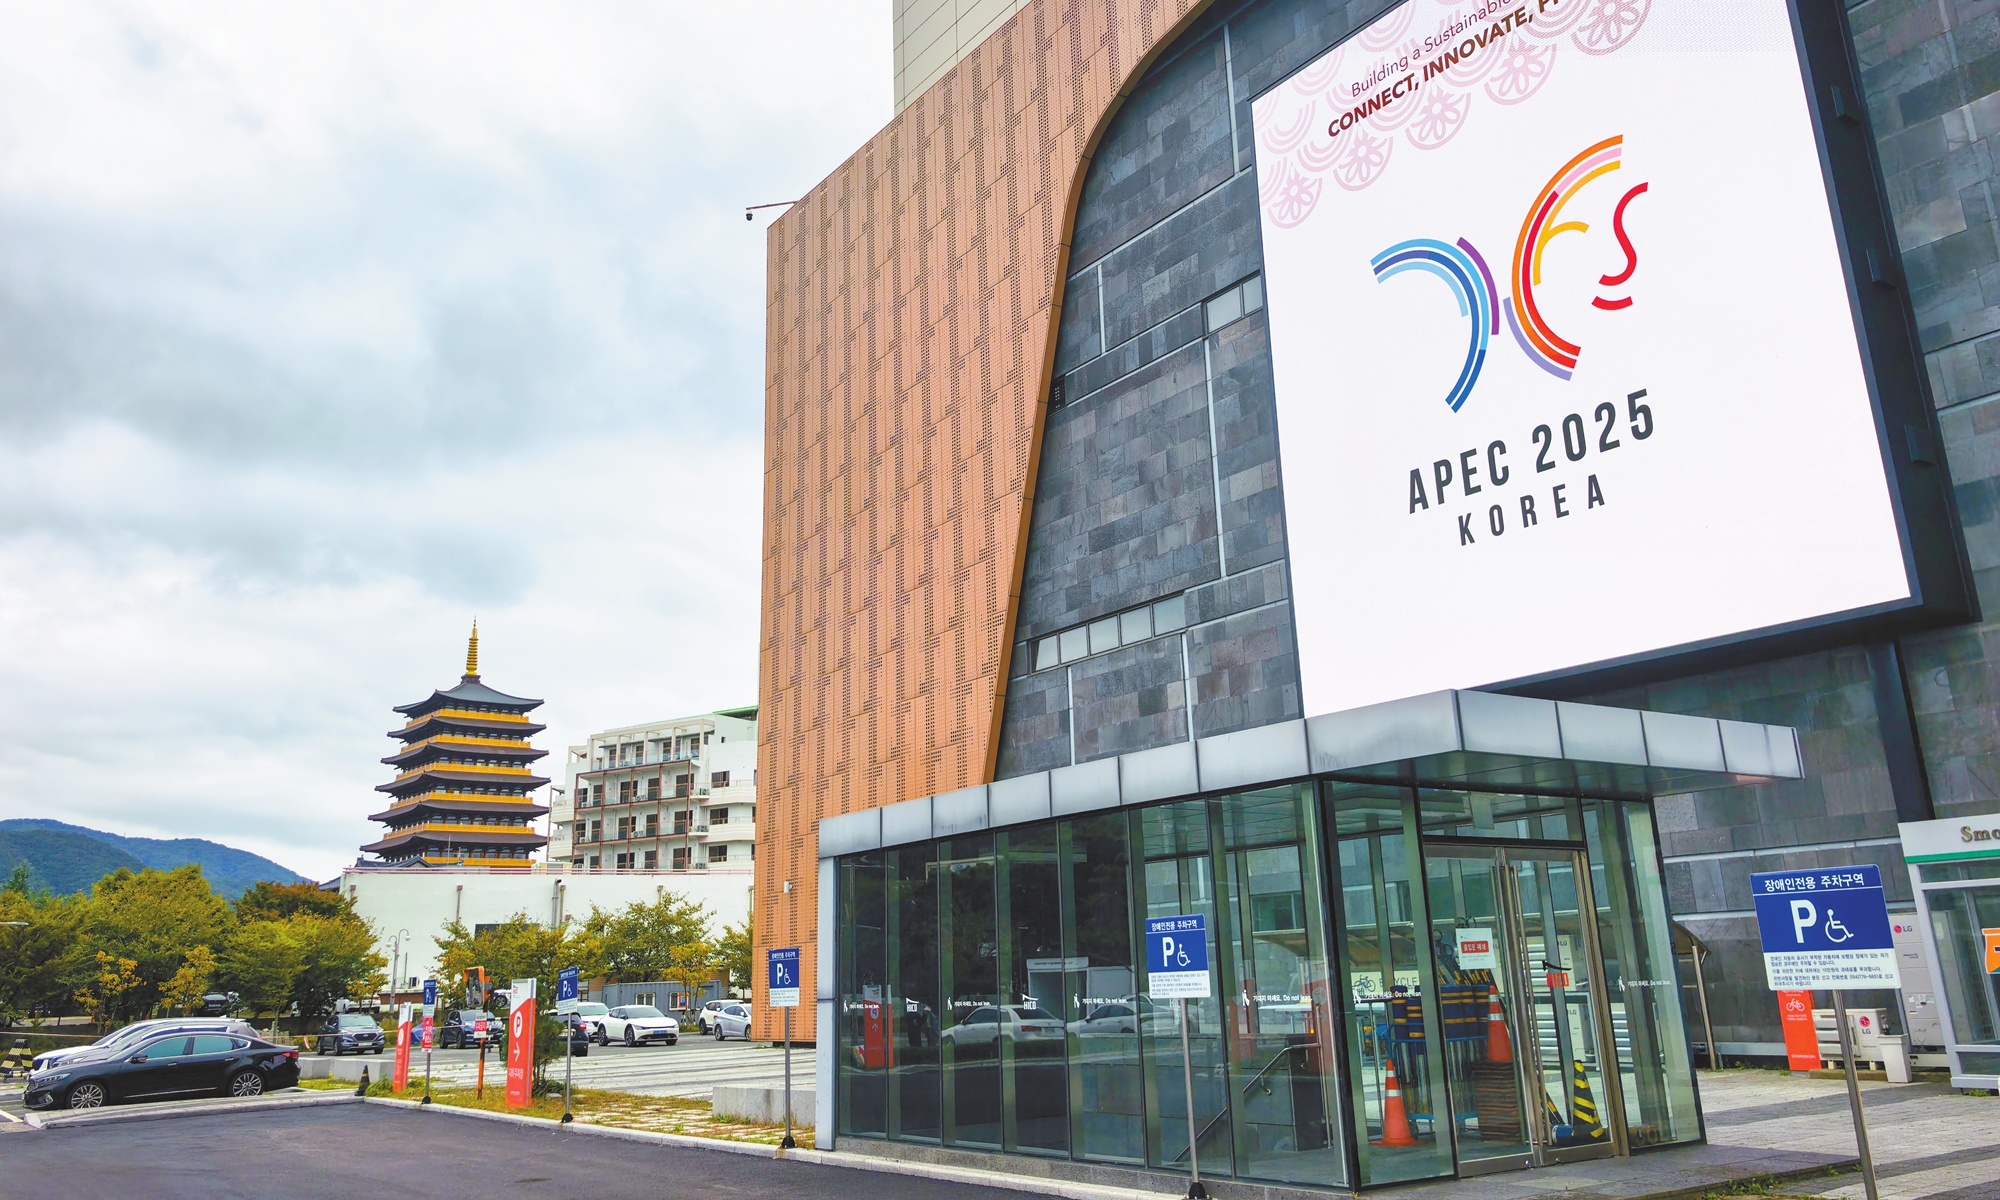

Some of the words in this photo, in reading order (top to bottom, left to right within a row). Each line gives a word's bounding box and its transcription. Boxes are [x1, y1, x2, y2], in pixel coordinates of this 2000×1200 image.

[1328, 73, 1419, 137] CONNECT,
[1423, 6, 1534, 82] INNOVATE,
[1352, 56, 1408, 97] Building
[1413, 48, 1421, 60] a
[1409, 440, 1509, 514] APEC
[1532, 388, 1654, 473] 2025
[1458, 474, 1605, 546] KOREA
[1764, 876, 1816, 892] 장애인전용
[1821, 873, 1865, 888] 주차구역
[1790, 899, 1817, 943] P
[1162, 936, 1175, 967] P
[563, 980, 568, 998] P
[777, 963, 783, 985] P
[1023, 1001, 1037, 1010] HICO
